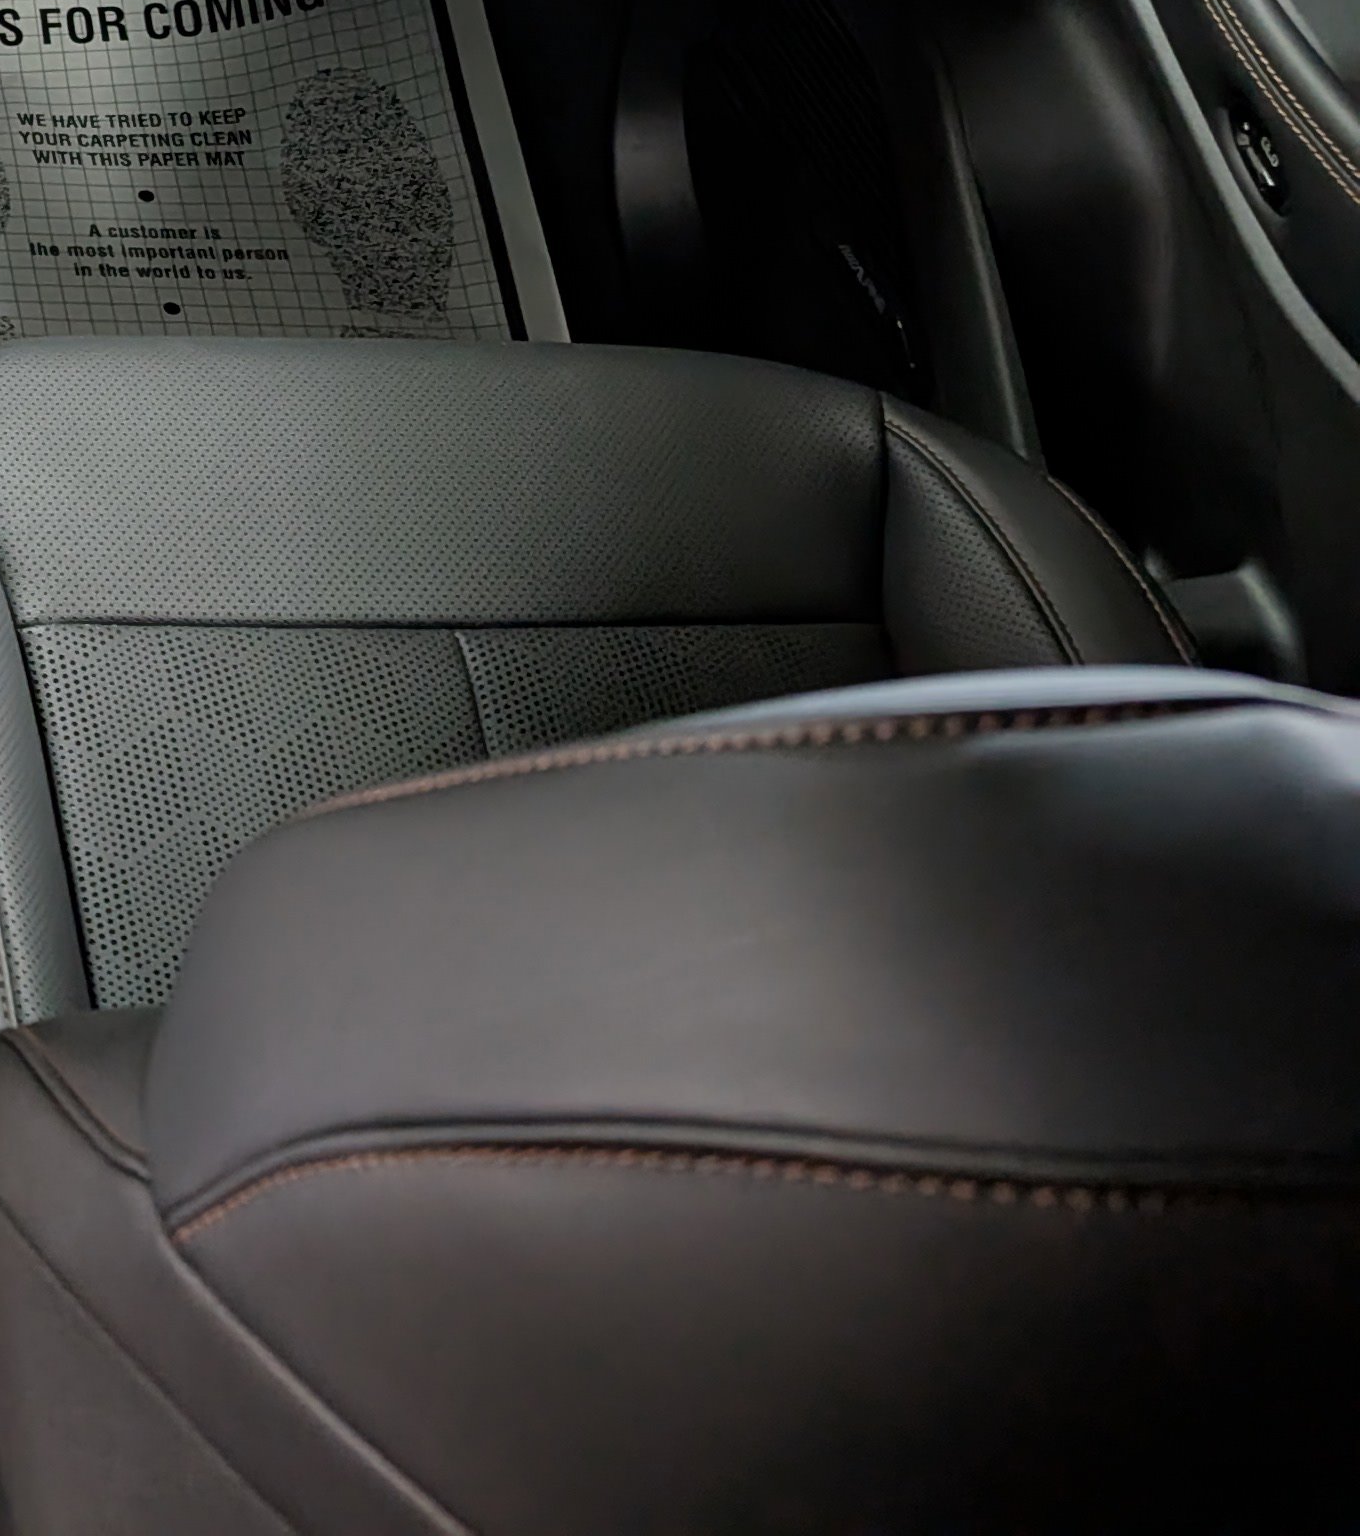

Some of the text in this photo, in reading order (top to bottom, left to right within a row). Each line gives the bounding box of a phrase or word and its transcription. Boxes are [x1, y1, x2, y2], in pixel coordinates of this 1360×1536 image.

[39, 5, 129, 45] FOR
[17, 107, 246, 129] WE HAVE TRIED TO KEEP
[18, 129, 252, 147] YOUR CARPETING CLEAN
[32, 149, 246, 166] WITH THIS PAPER MAT
[89, 224, 222, 240] A customer is
[30, 242, 289, 262] the most important person
[74, 263, 253, 280] in the world to us.
